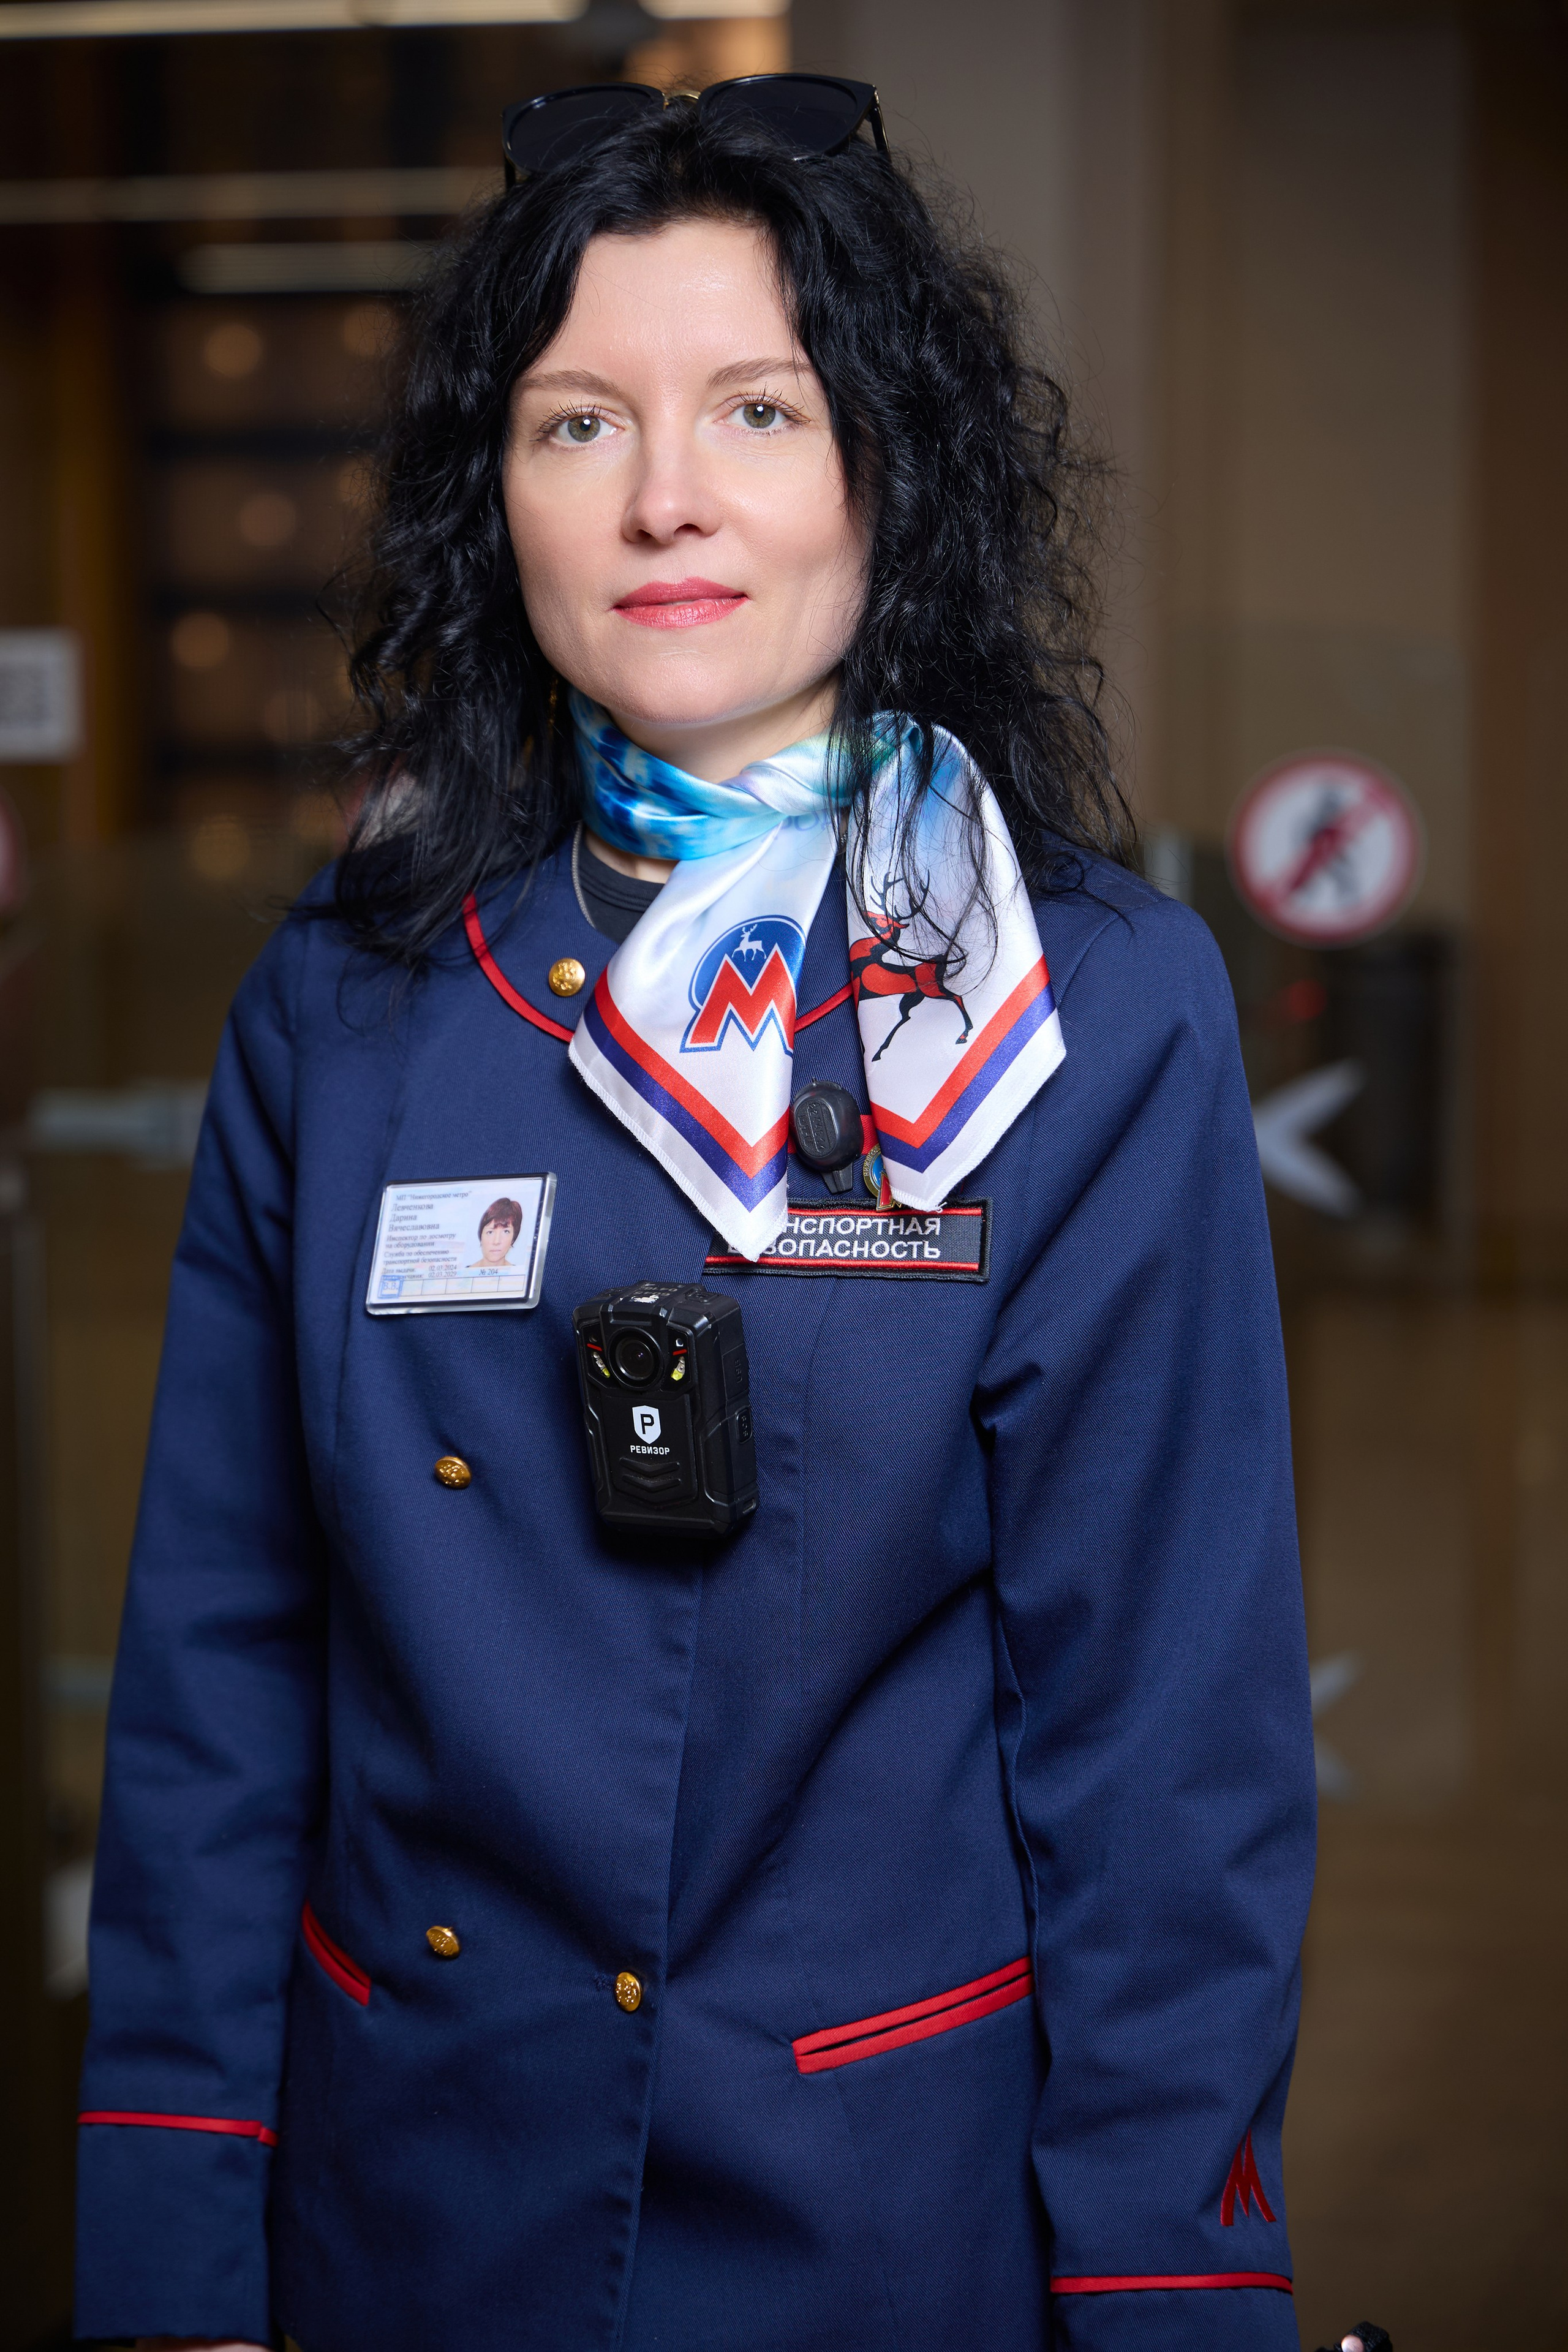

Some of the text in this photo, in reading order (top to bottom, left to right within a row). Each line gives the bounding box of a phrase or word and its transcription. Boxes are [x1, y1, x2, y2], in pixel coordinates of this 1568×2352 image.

[391, 1203, 434, 1212] Левченкова
[389, 1214, 418, 1223] Дарина
[388, 1224, 440, 1232] Вячеславовна
[734, 1359, 743, 1384] USB
[630, 1445, 670, 1455] РЕВИЗОР
